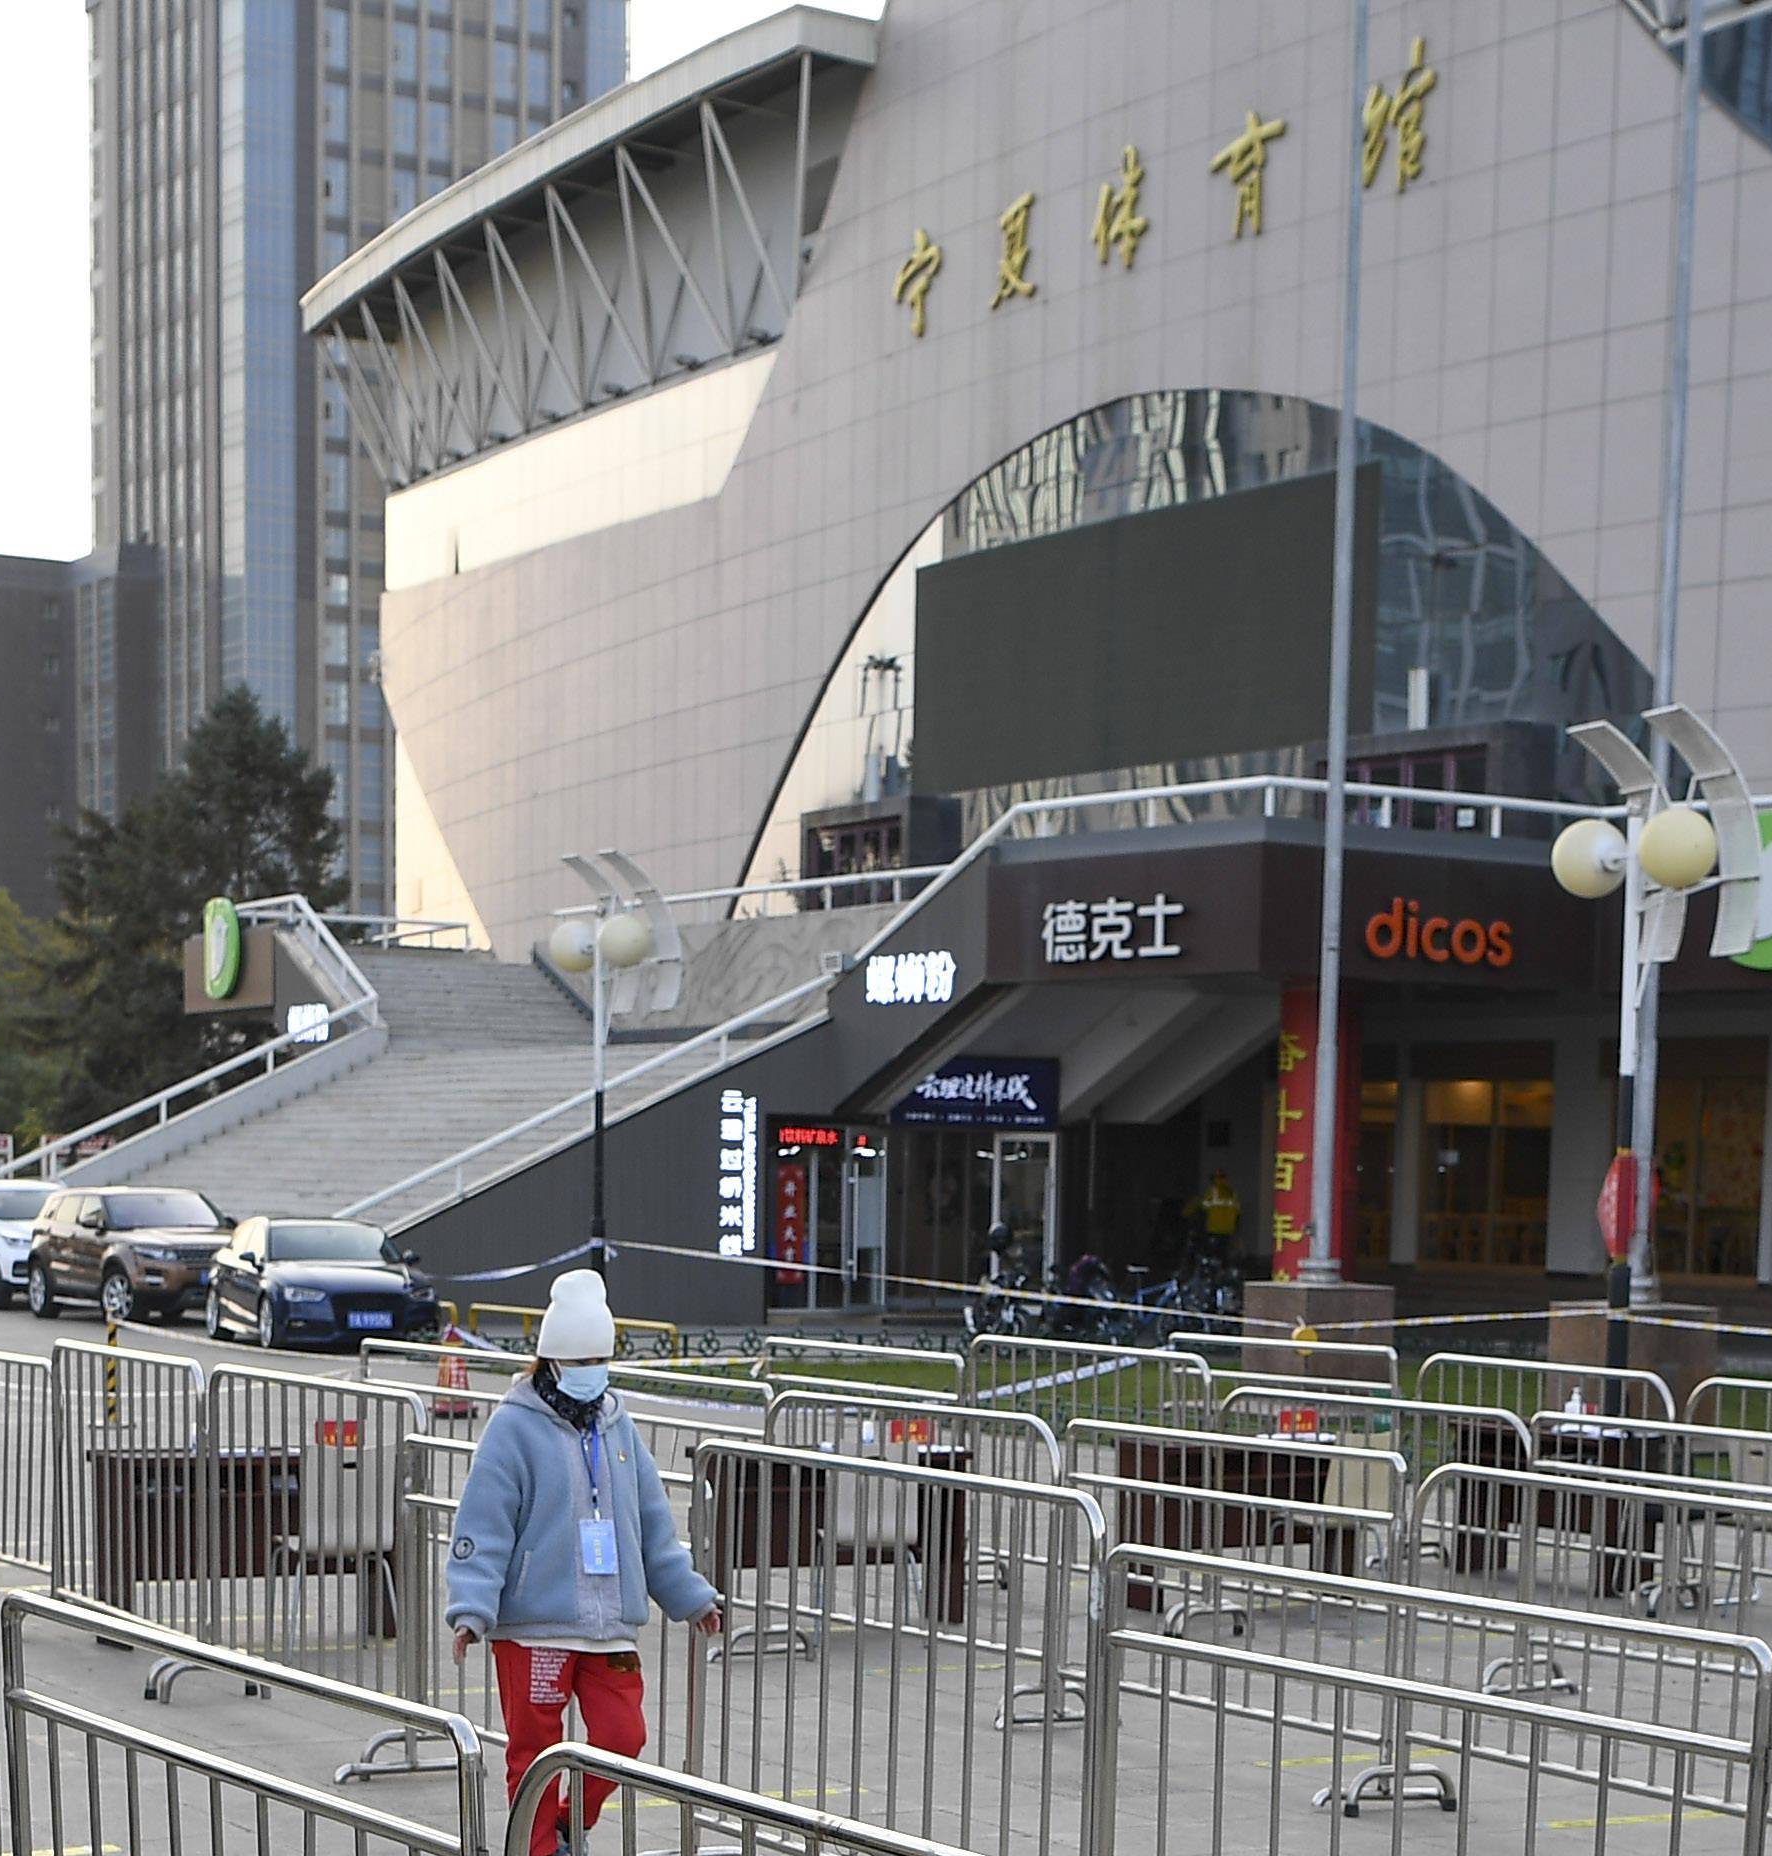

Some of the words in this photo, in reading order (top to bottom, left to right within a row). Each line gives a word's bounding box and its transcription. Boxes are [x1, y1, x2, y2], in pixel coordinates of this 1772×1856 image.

[892, 35, 1439, 338] 宁夏体育馆
[1041, 894, 1185, 965] 德克士
[1366, 898, 1512, 967] dicos
